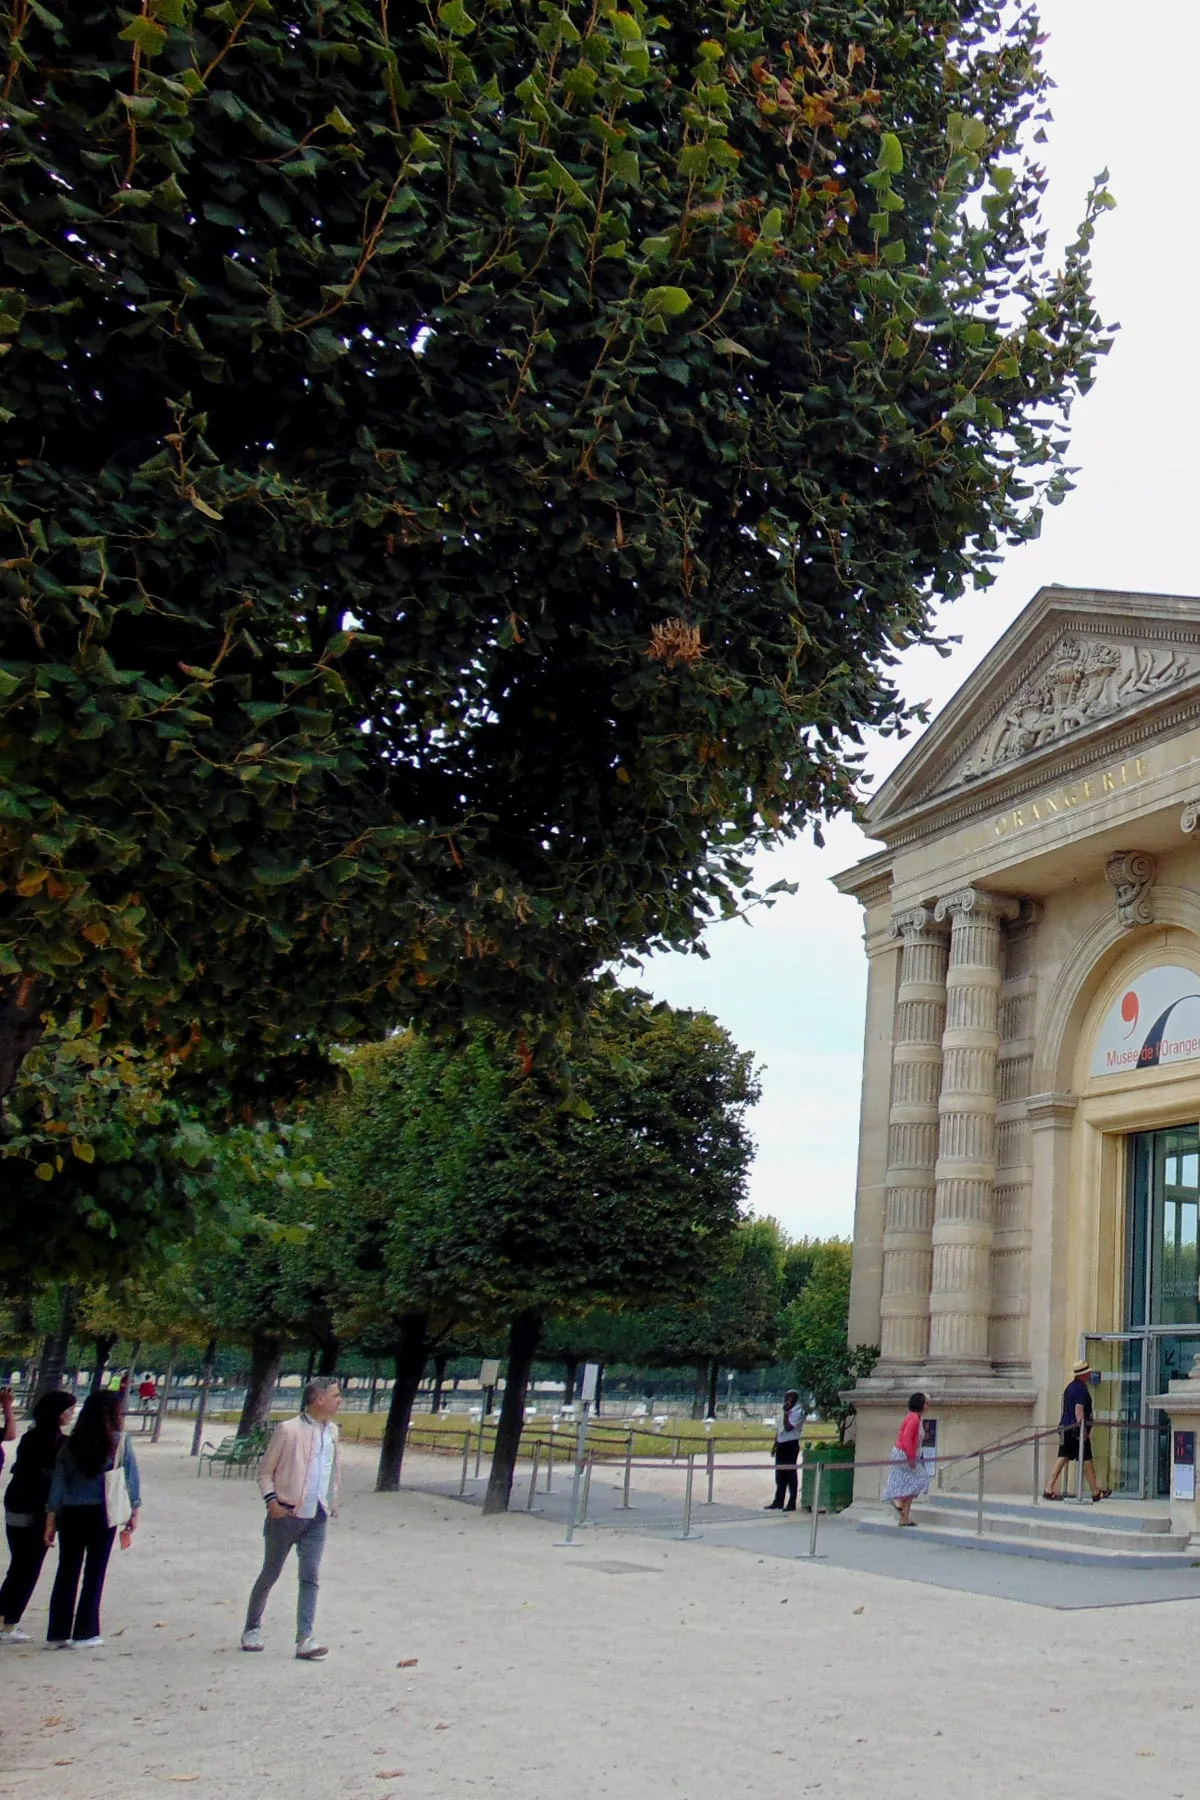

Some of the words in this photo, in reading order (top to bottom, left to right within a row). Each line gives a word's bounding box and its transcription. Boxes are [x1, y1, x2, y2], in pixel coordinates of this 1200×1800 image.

[995, 756, 1150, 836] ORANGERIE
[1106, 1047, 1139, 1067] Musée
[1141, 1045, 1153, 1061] de
